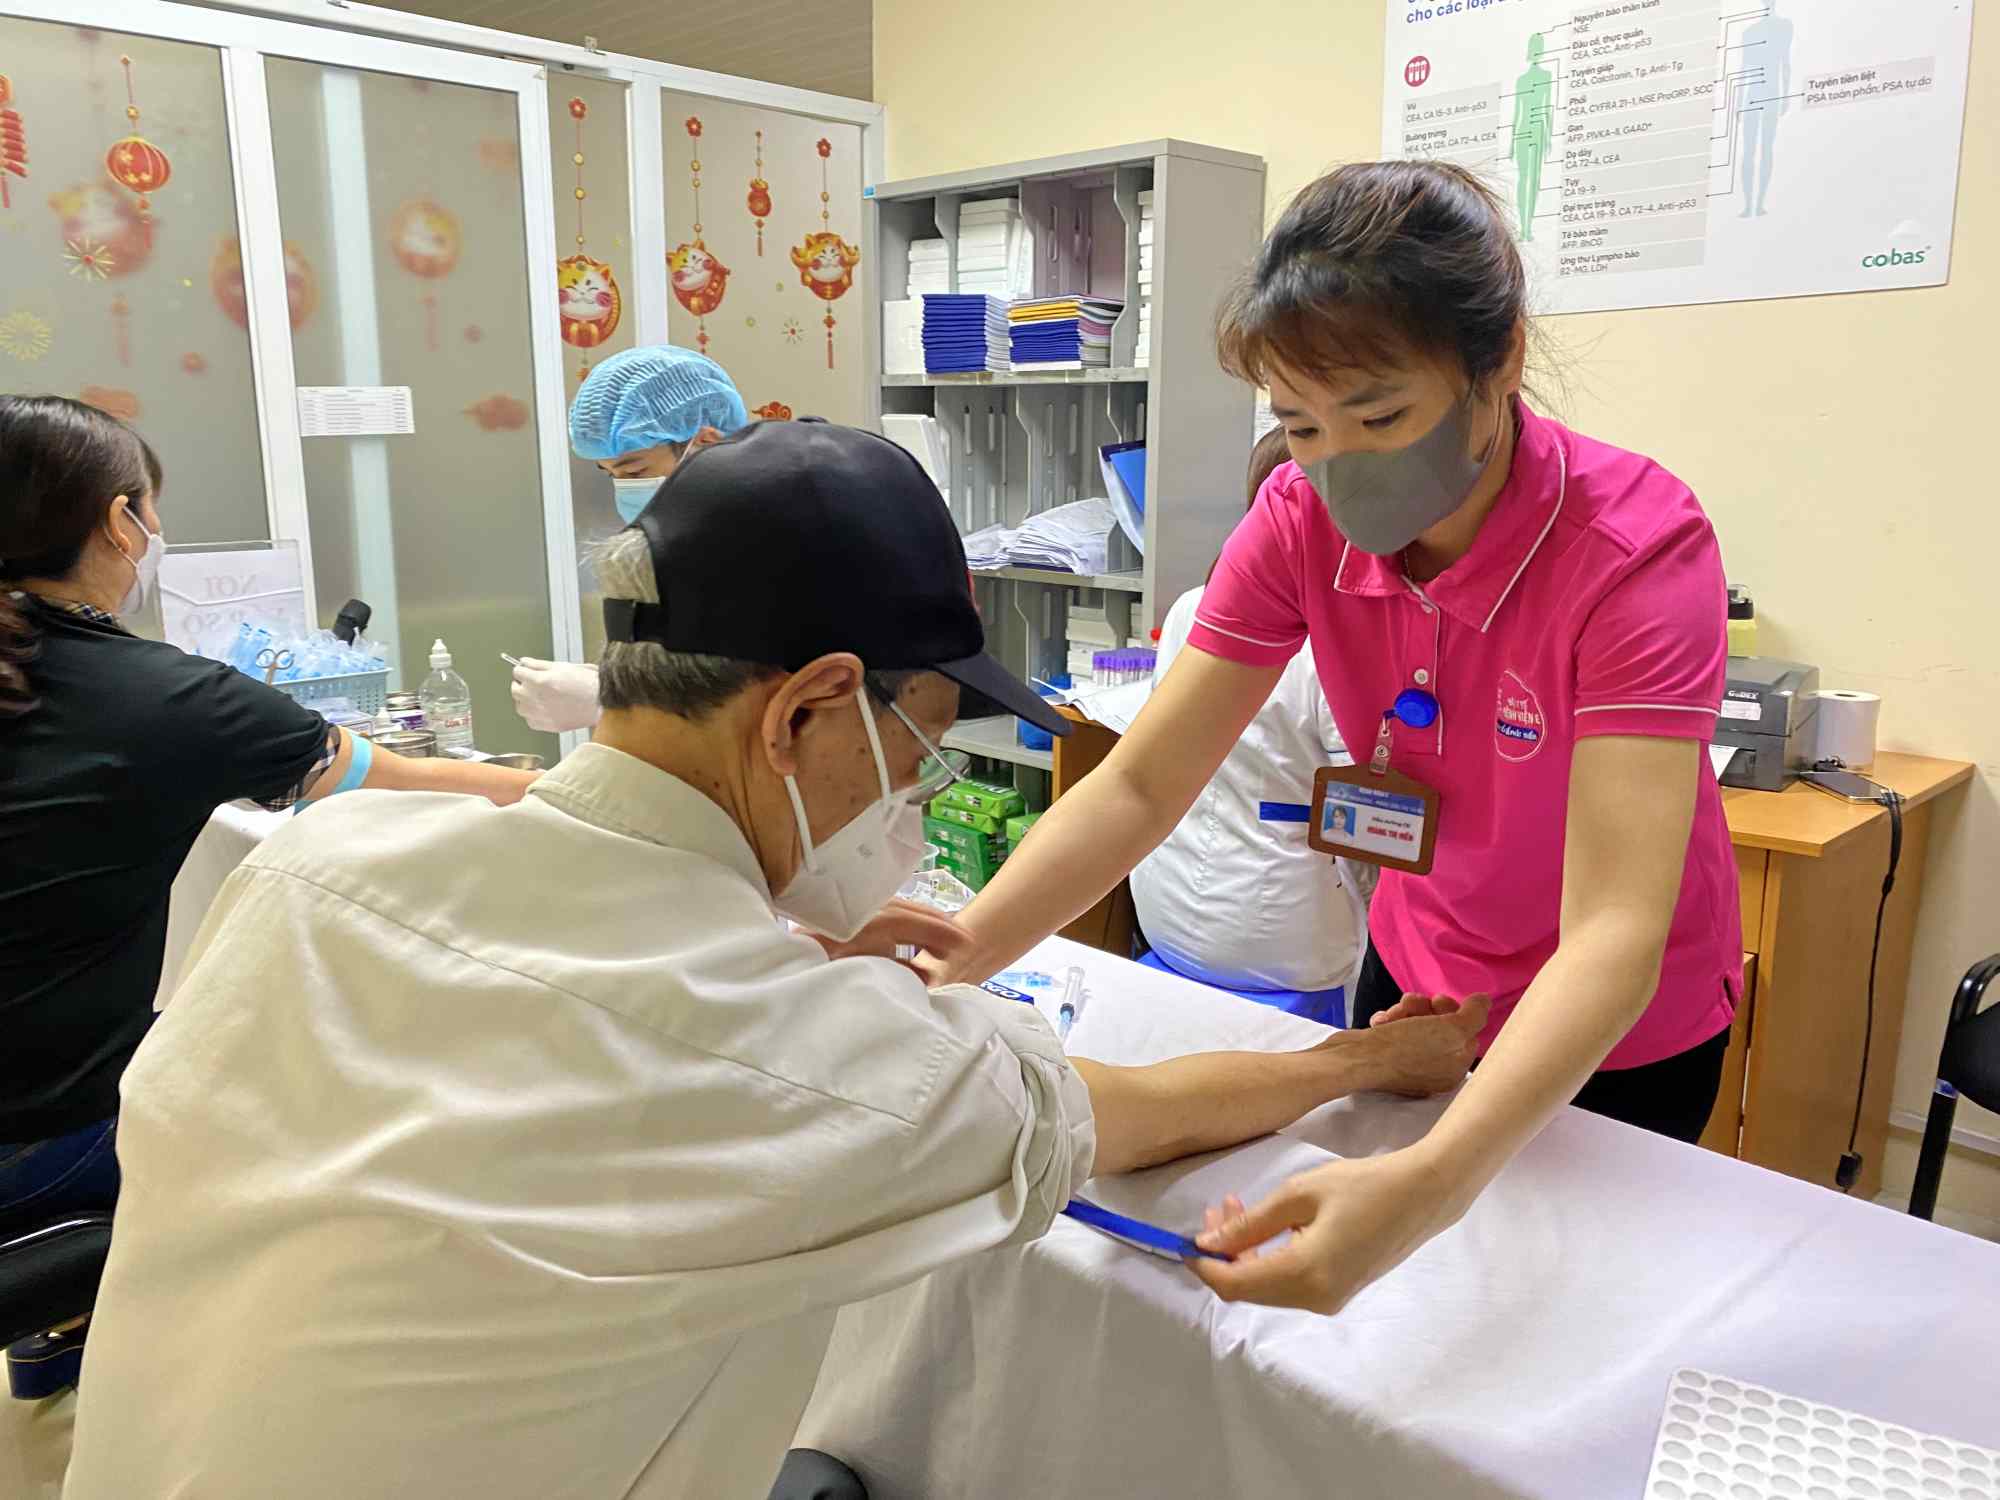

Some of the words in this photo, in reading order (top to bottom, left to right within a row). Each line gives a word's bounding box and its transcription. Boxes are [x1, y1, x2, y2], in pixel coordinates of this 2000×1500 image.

[1406, 9, 1432, 23] cho
[1436, 1, 1462, 16] các
[1573, 25, 1591, 34] NSE
[1613, 37, 1652, 53] Anti-p53
[1649, 60, 1684, 75] Anti-Tg
[1860, 70, 1876, 82] liệt
[1807, 93, 1827, 104] PSA
[1882, 80, 1904, 92] PSA
[1567, 124, 1584, 133] Gan
[1602, 154, 1620, 165] CEA
[1564, 188, 1577, 197] CA
[1582, 211, 1595, 221] CA
[1618, 207, 1632, 217] CA
[1657, 198, 1697, 212] Anti-p53
[1591, 250, 1623, 264] Lympho
[1862, 248, 1925, 268] cobas
